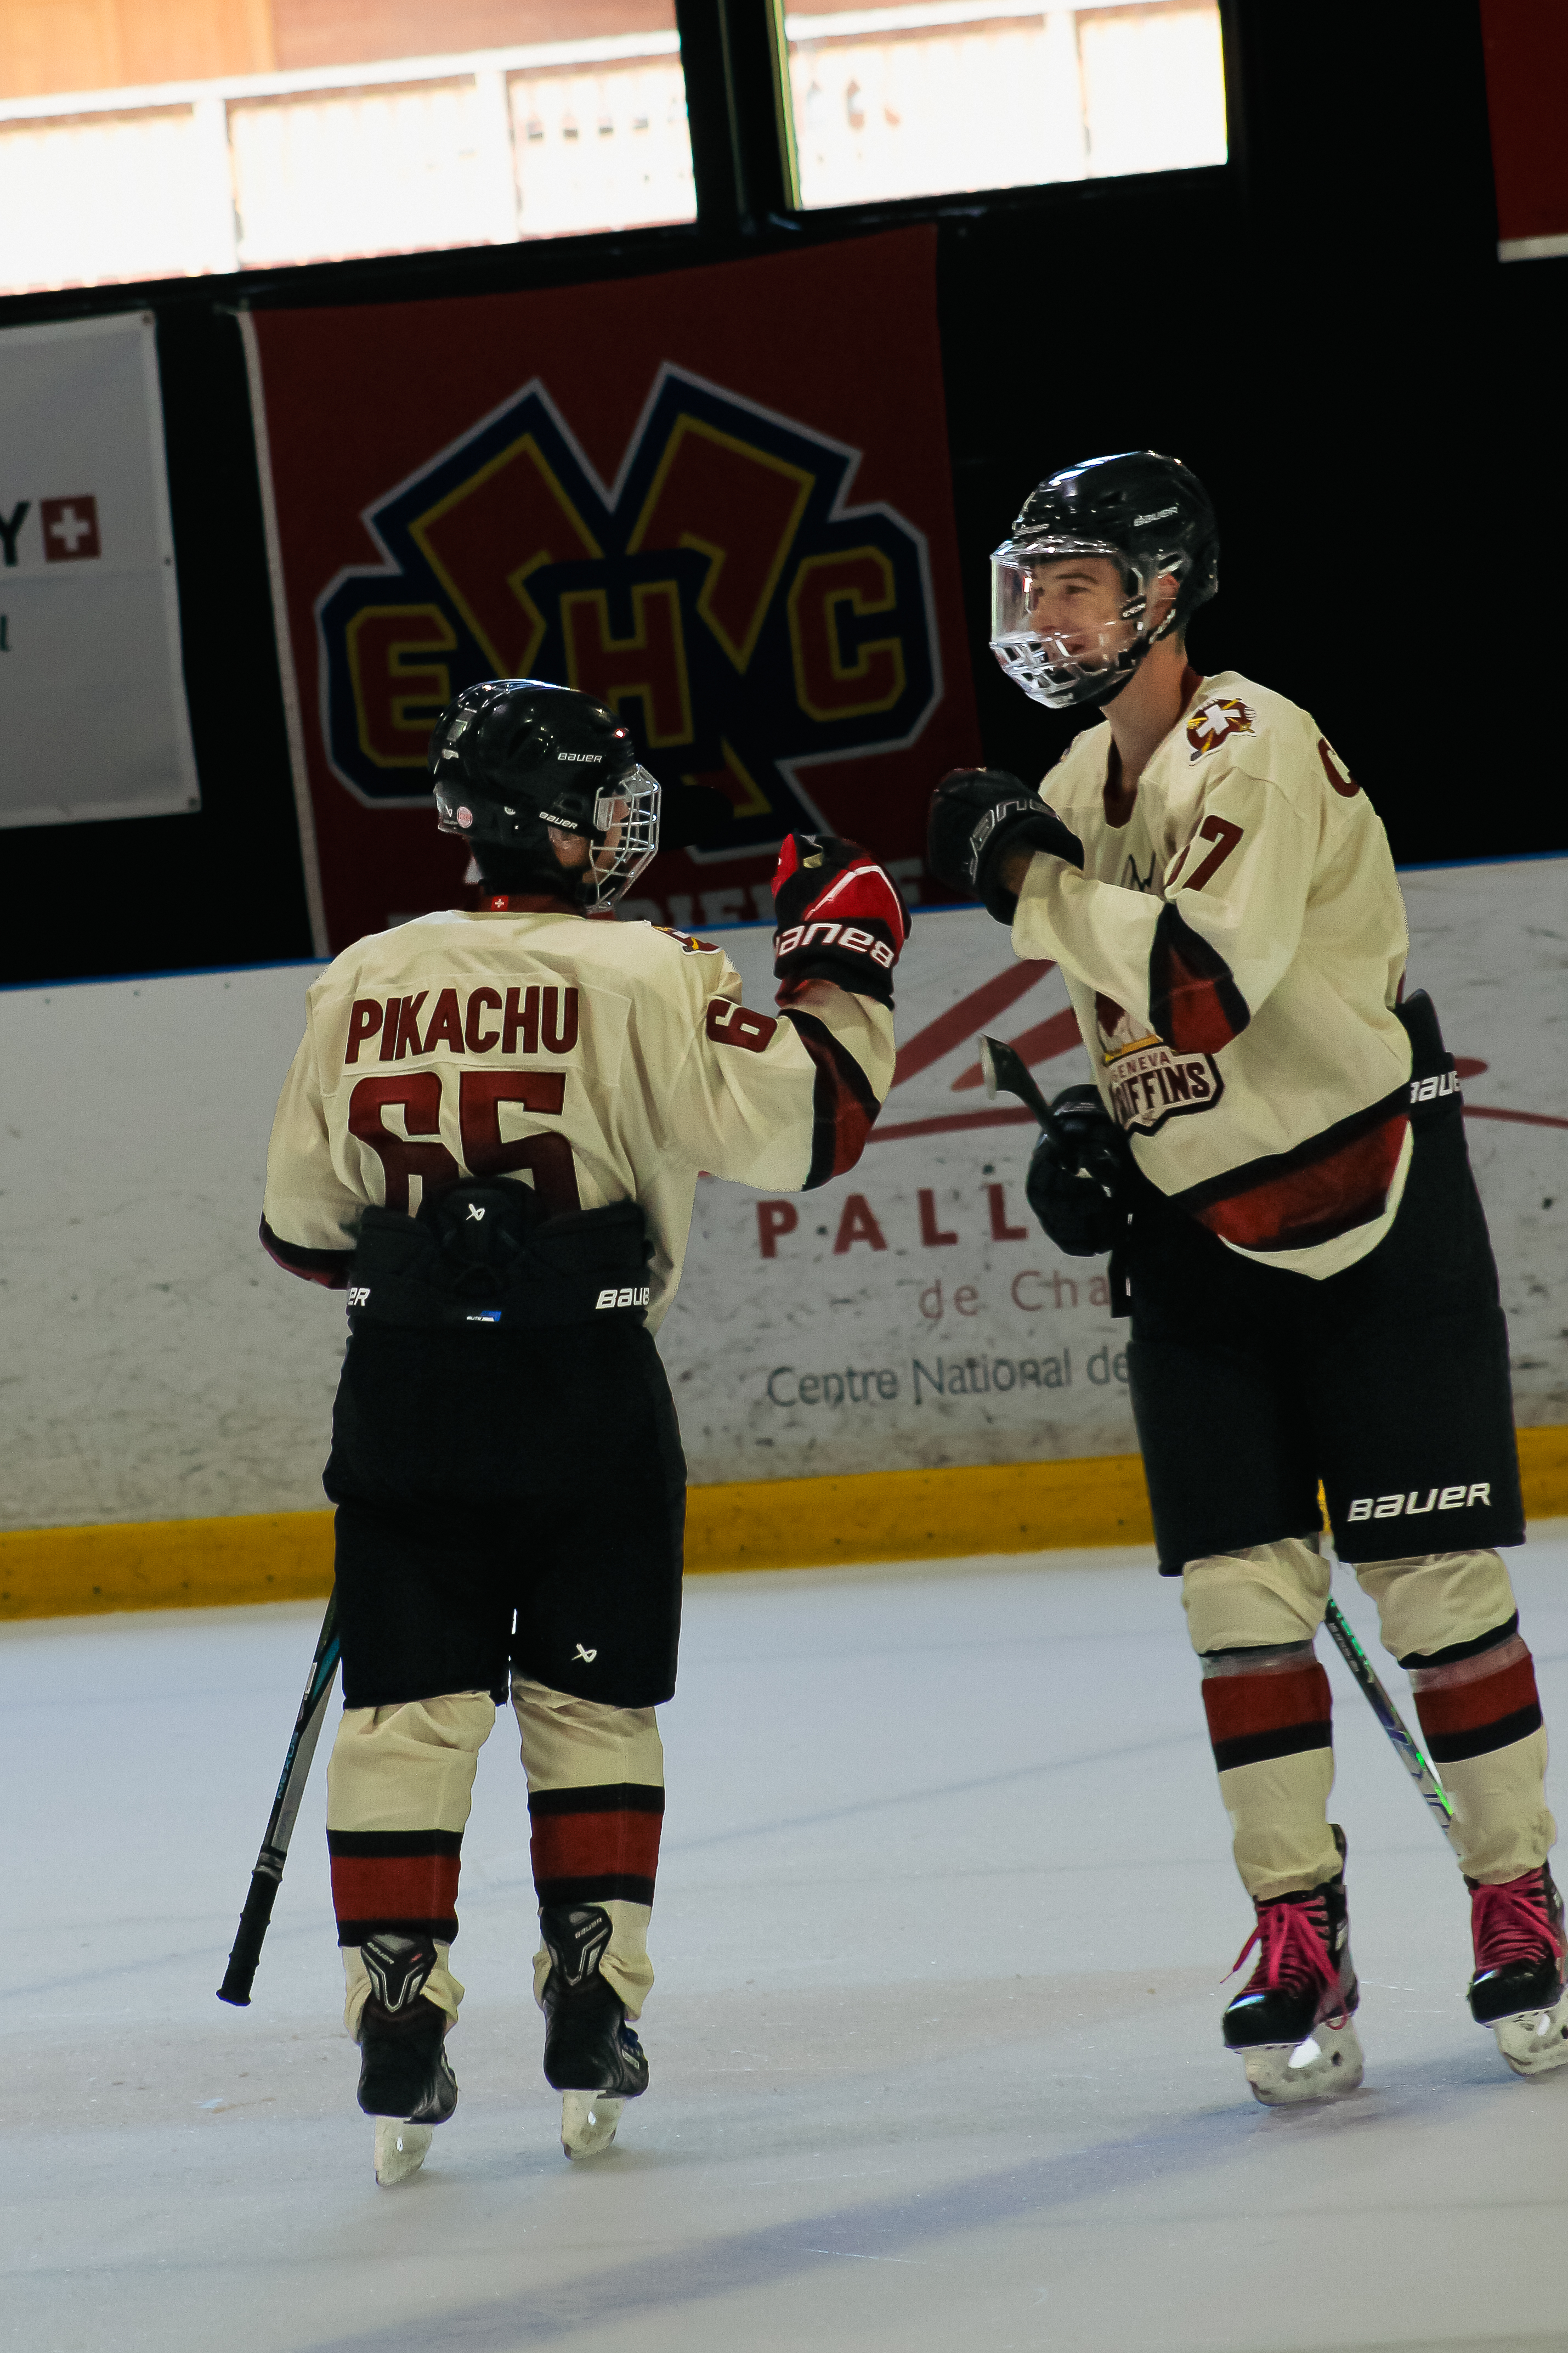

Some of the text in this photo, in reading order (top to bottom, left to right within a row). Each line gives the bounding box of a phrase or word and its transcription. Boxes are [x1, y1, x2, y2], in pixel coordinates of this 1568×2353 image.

[557, 752, 602, 764] BAUER
[539, 811, 578, 830] BAUER
[1167, 815, 1244, 891] 7
[775, 923, 895, 968] BAUE
[344, 985, 580, 1065] PIKACHU
[348, 1070, 582, 1216] 65
[919, 1279, 981, 1319] de
[768, 1365, 899, 1408] Centre
[913, 1347, 1073, 1404] National
[1347, 1482, 1492, 1522] BAUER
